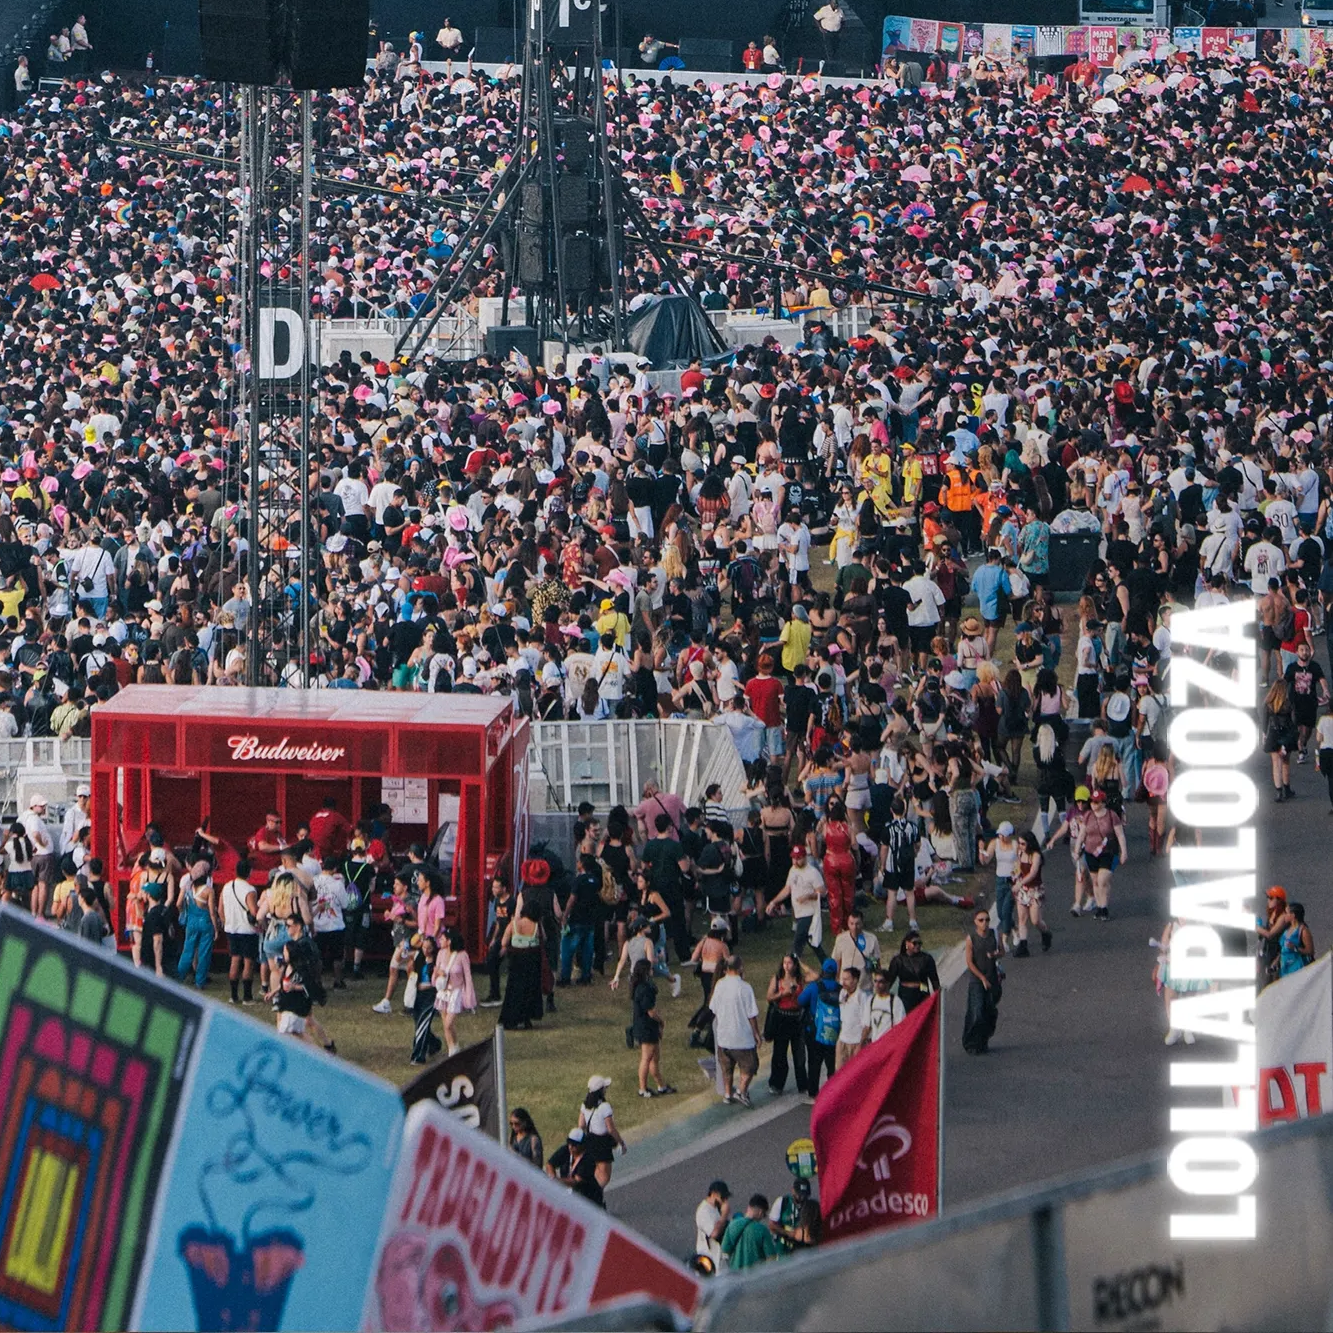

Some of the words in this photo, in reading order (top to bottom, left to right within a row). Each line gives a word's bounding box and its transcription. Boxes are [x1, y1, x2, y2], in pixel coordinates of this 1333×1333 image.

[1091, 30, 1114, 39] MADE
[1098, 38, 1108, 46] IN
[1091, 45, 1115, 54] LOLLA
[1096, 53, 1109, 62] BR
[226, 733, 346, 762] Budweiser
